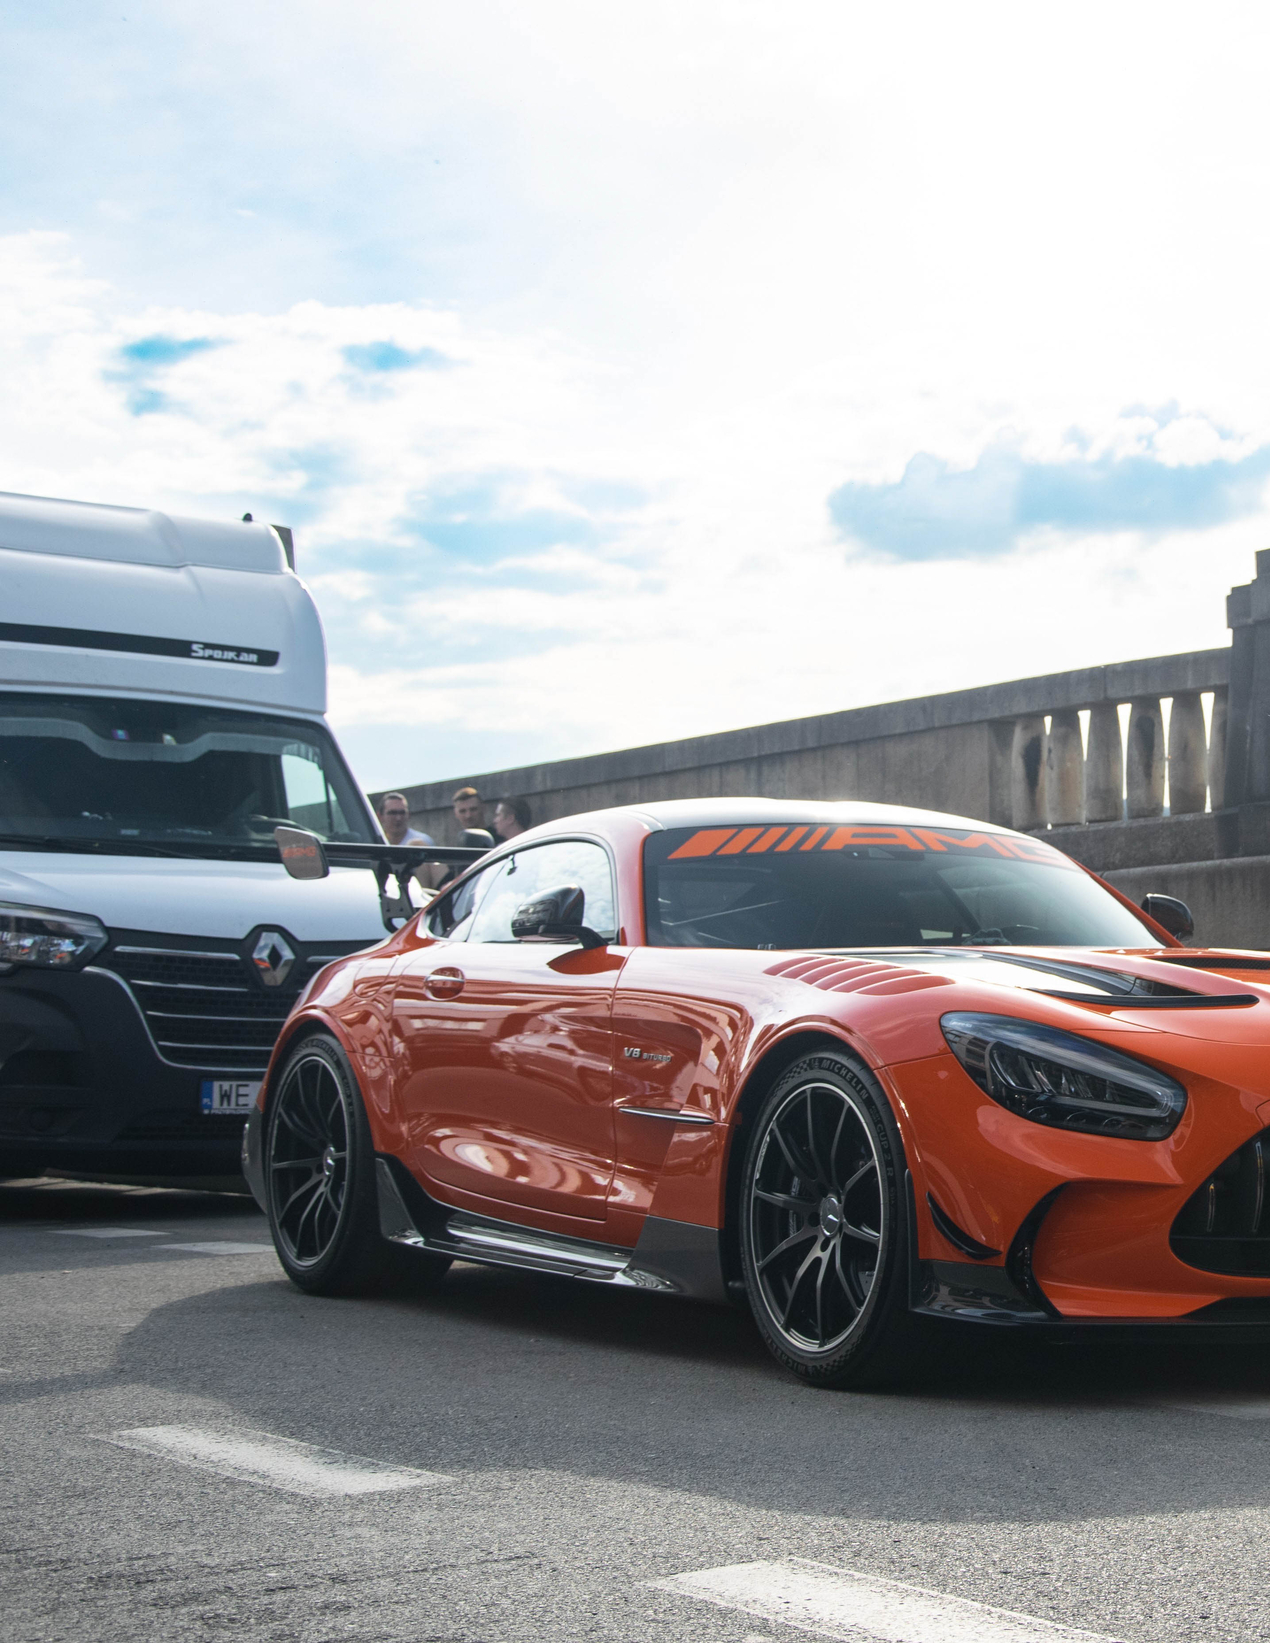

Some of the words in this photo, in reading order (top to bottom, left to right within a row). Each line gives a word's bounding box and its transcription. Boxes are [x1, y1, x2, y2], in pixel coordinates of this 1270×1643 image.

[821, 826, 1077, 868] AMG
[624, 1047, 641, 1058] V8
[643, 1053, 672, 1063] BITURBO
[219, 1084, 250, 1107] WE
[820, 1057, 869, 1099] MICHELIN
[876, 1123, 889, 1150] CUP
[886, 1168, 894, 1178] R
